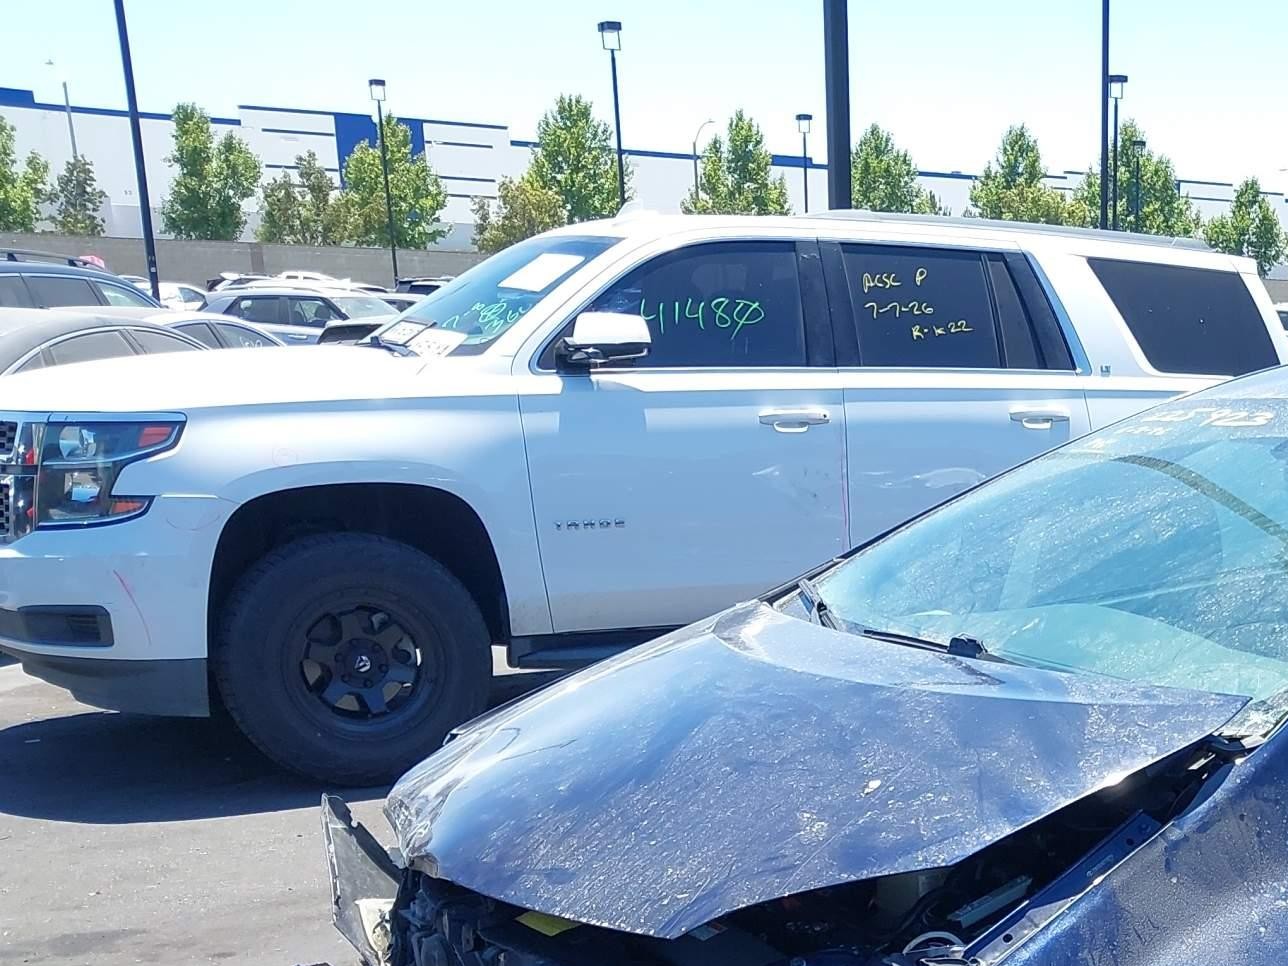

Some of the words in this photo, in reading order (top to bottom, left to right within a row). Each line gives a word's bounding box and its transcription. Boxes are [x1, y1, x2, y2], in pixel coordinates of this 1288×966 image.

[914, 267, 928, 286] P
[864, 301, 934, 320] 7-7-26
[553, 518, 625, 531] TAHOE
